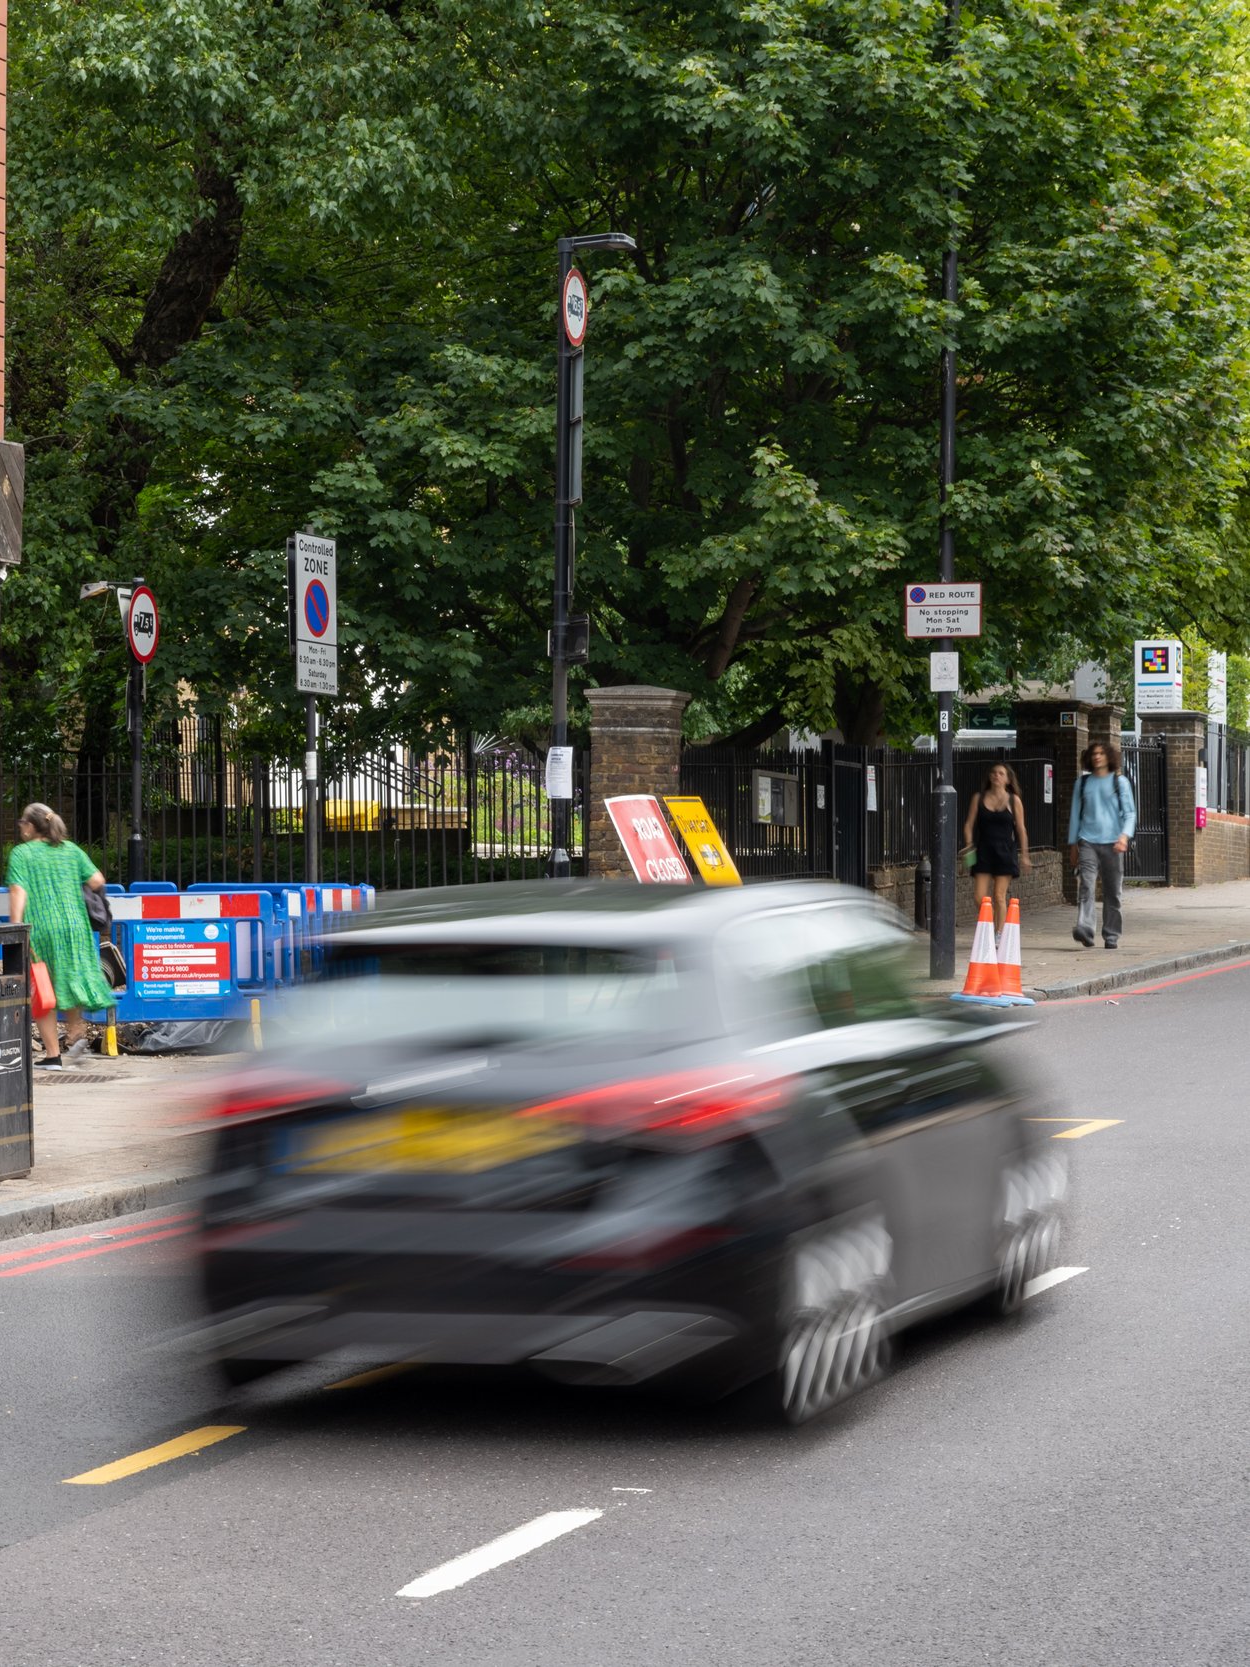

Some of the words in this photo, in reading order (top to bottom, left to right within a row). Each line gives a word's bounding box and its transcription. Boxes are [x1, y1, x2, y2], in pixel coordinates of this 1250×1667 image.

[299, 539, 334, 557] Controlled
[304, 557, 329, 576] ZONE
[933, 608, 969, 616] stopping
[308, 668, 327, 680] Saturday
[632, 816, 665, 840] ROAD
[676, 814, 714, 834] Diversion
[645, 857, 687, 882] CLOSED
[163, 926, 185, 934] making
[0, 983, 18, 997] Litter
